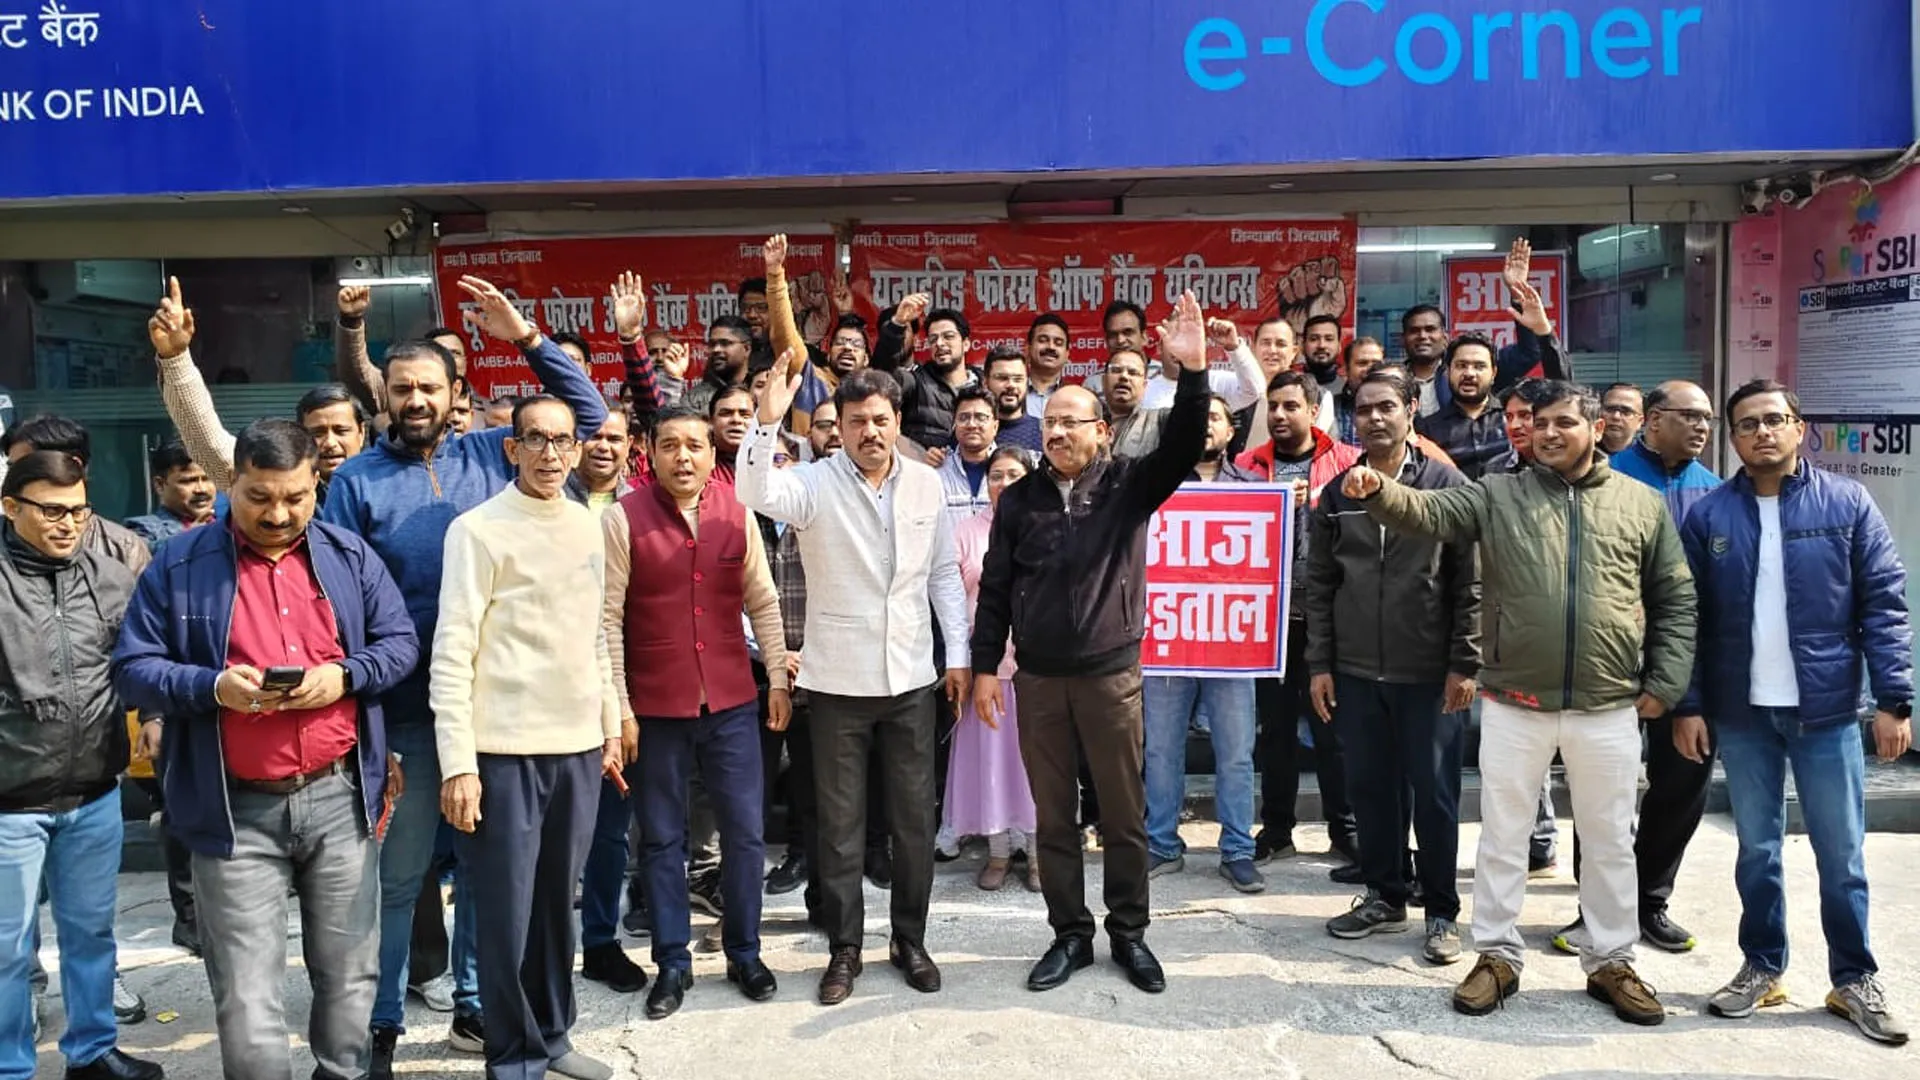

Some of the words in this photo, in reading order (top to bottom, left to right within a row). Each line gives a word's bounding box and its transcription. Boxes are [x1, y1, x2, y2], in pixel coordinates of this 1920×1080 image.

[38, 0, 100, 48] बैंक
[1183, 0, 1702, 91] e-Corner
[43, 88, 94, 120] OF
[103, 85, 205, 118] INDIA
[1876, 232, 1917, 273] SBI
[973, 255, 1038, 312] फोरम
[1048, 254, 1105, 311] ऑफ
[1112, 253, 1156, 306] बैंक
[541, 286, 596, 335] फोरम
[1872, 422, 1912, 456] SBI
[1846, 463, 1858, 475] to
[1860, 461, 1903, 478] Greater
[1147, 510, 1276, 569] आज
[1143, 583, 1275, 658] ड़ताल
